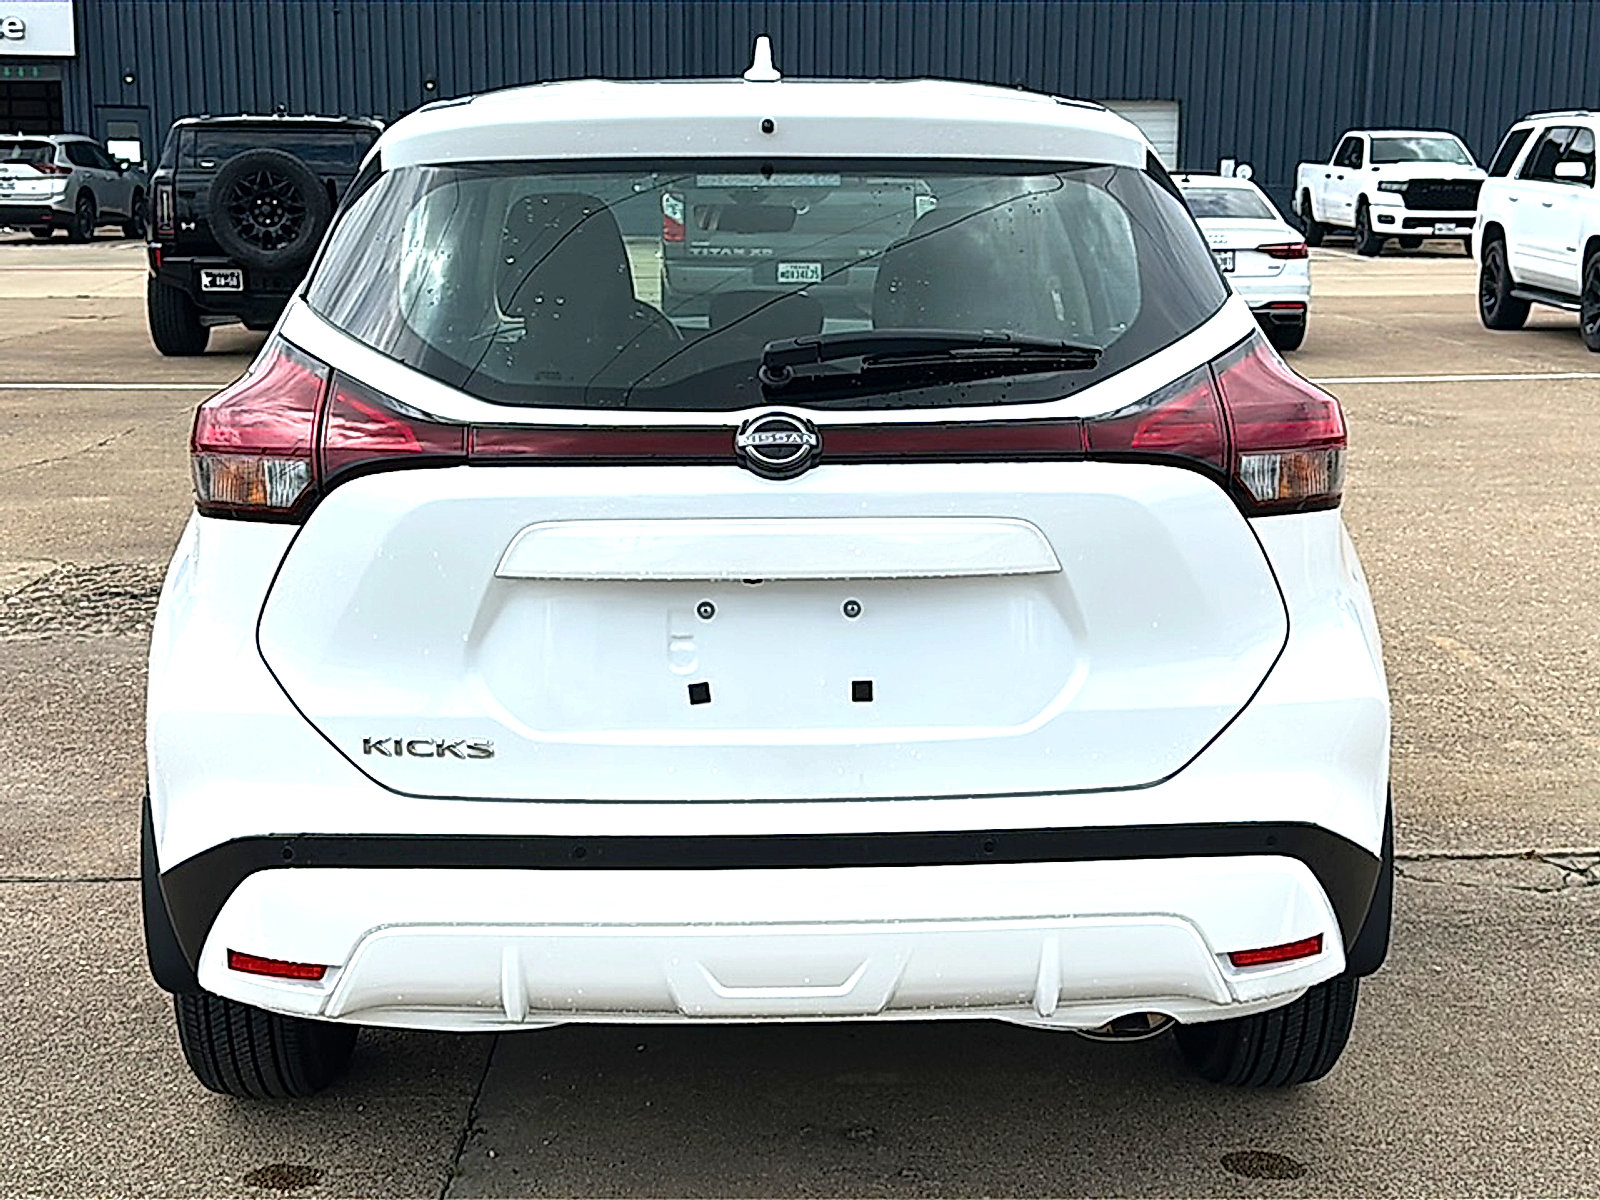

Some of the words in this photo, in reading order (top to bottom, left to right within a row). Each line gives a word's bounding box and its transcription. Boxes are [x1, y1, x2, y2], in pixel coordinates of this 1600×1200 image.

[0, 15, 25, 40] e
[689, 248, 745, 256] TITAN
[738, 431, 817, 446] NISSAN
[361, 736, 495, 760] KICKS
